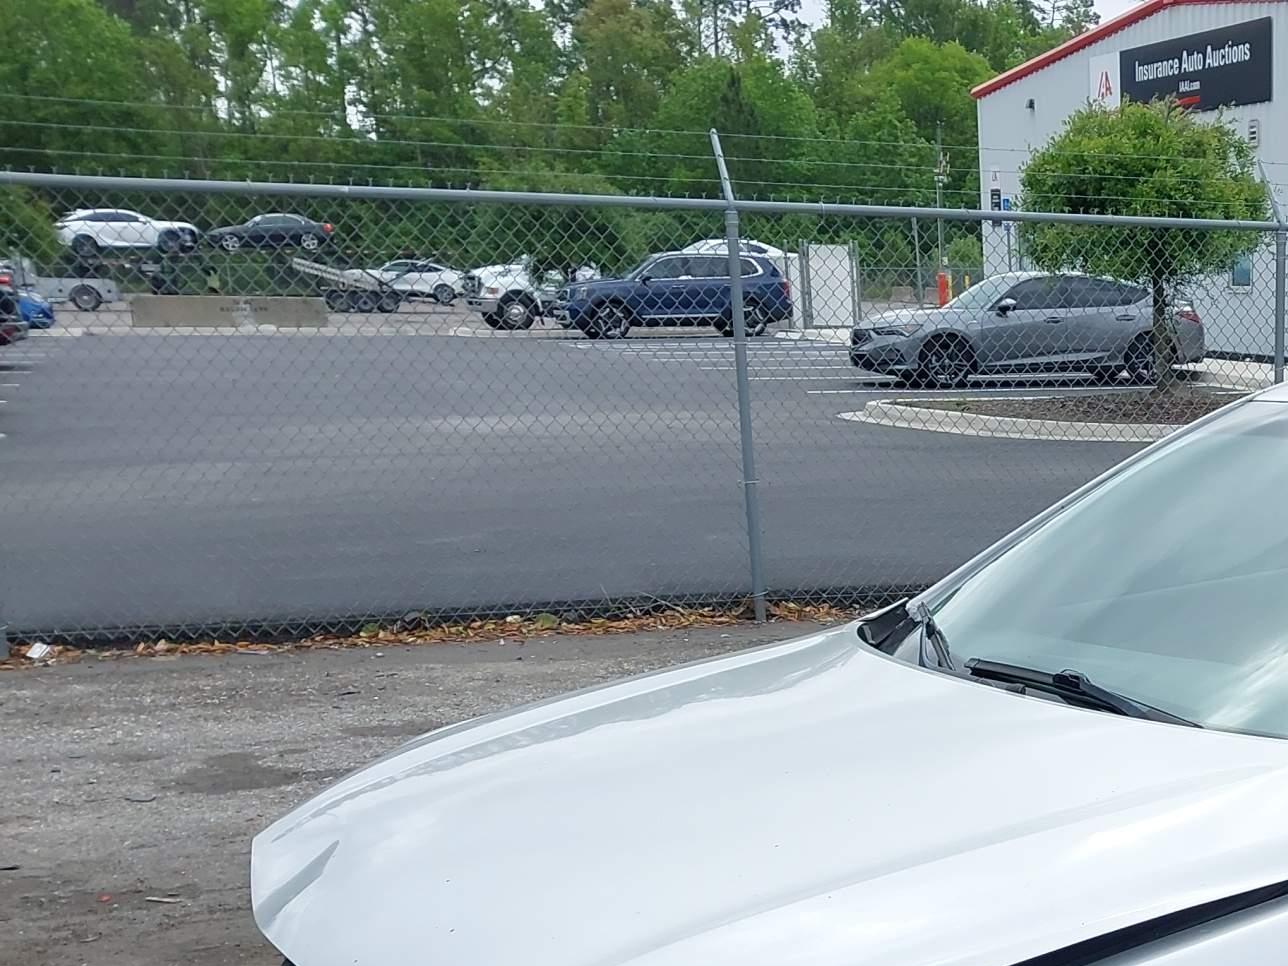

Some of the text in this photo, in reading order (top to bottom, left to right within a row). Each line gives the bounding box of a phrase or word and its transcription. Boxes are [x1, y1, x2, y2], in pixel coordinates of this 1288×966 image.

[1135, 41, 1250, 81] Insurance Auto Auctions
